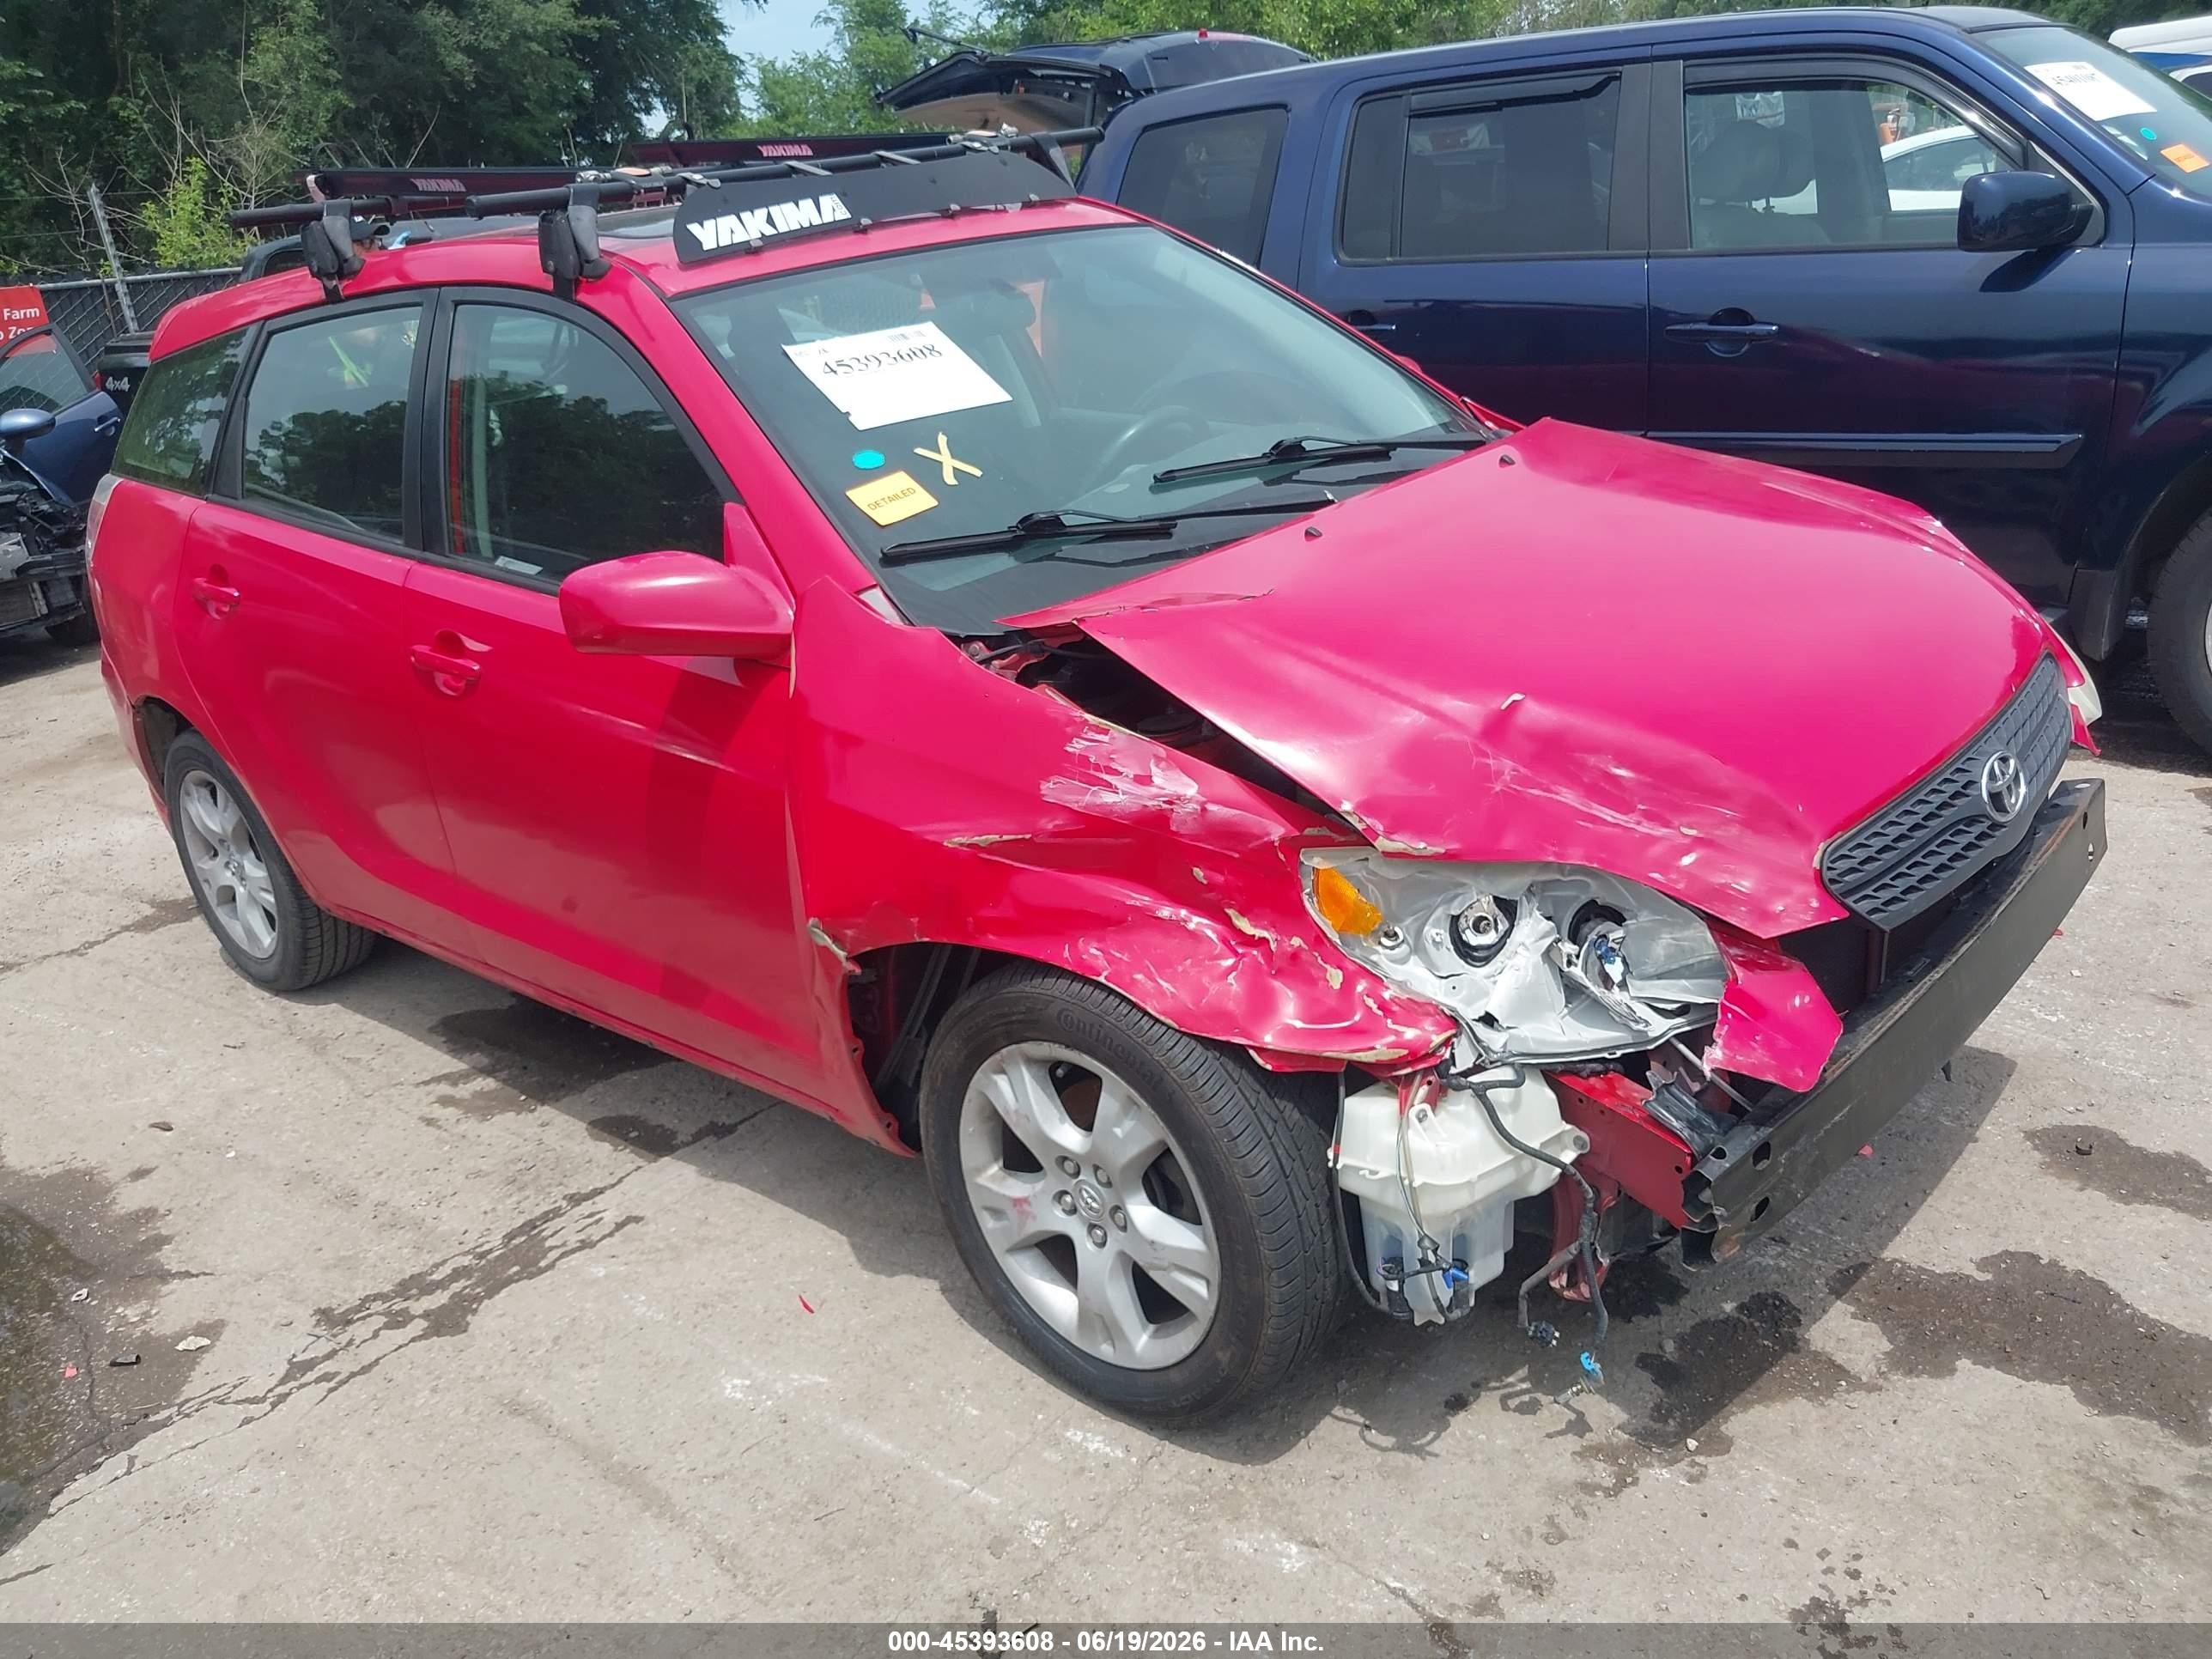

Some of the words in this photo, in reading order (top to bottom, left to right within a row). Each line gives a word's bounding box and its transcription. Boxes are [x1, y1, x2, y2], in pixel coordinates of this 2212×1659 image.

[757, 144, 814, 157] YAKIMA
[410, 179, 467, 192] YAKIMA
[686, 192, 853, 252] YAKIMA
[3, 307, 40, 320] Farm
[823, 343, 943, 376] 45393608
[106, 376, 131, 392] 4x4
[866, 486, 917, 511] DETAILED
